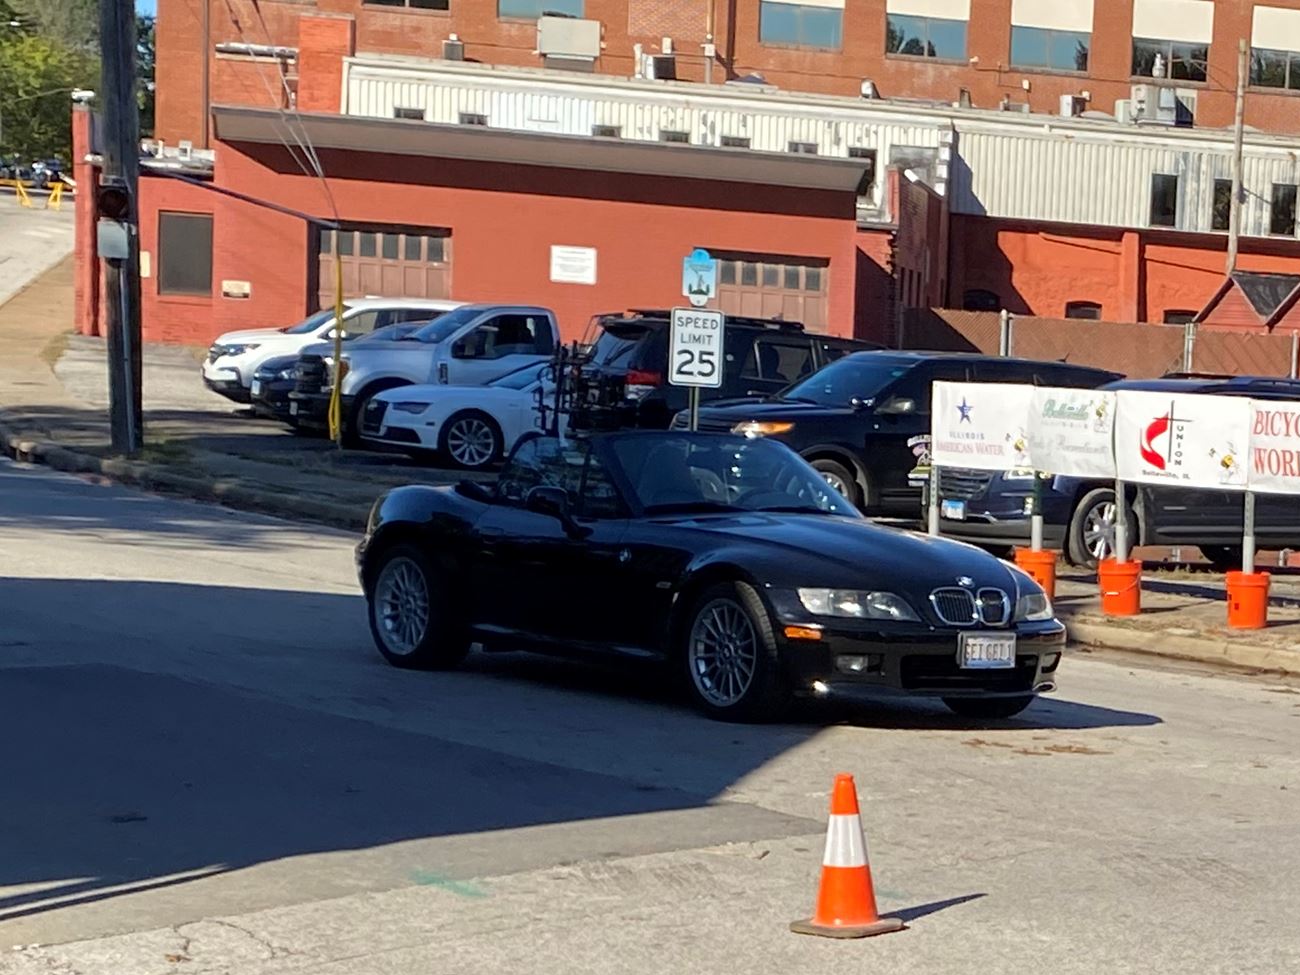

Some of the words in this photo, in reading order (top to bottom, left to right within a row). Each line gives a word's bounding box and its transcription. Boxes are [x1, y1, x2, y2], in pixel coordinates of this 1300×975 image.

[676, 317, 719, 330] SPEED
[680, 333, 713, 345] LIMIT
[676, 349, 716, 377] 25
[975, 443, 1005, 456] WATER
[1174, 425, 1184, 466] UNION
